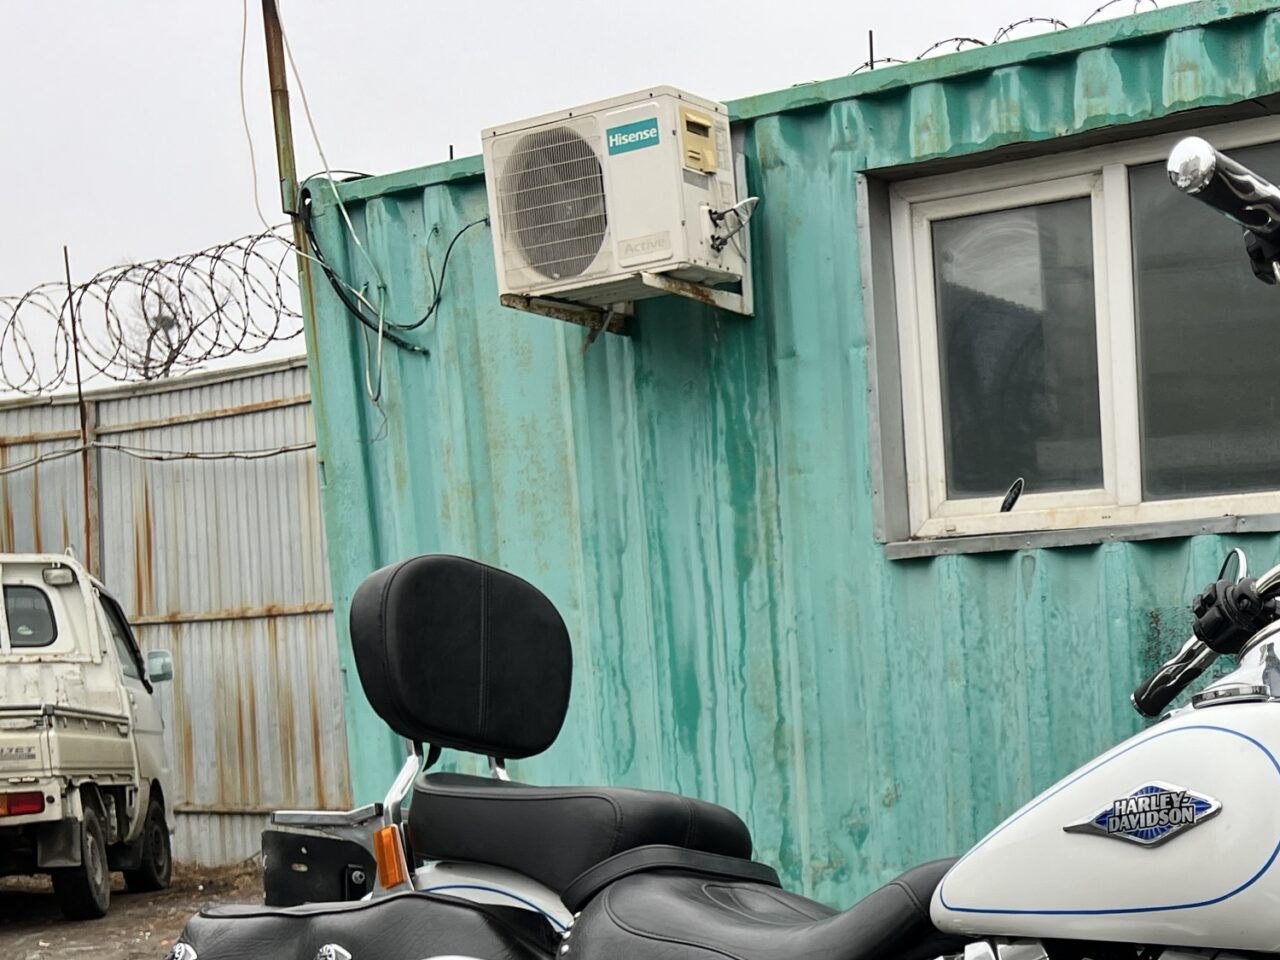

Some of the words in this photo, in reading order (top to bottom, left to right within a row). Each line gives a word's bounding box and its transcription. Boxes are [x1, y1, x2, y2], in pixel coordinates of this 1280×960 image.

[608, 126, 658, 148] Hisense
[624, 237, 666, 256] Active
[1114, 791, 1191, 816] HARLEY-
[1107, 806, 1195, 833] DAVIDSON
